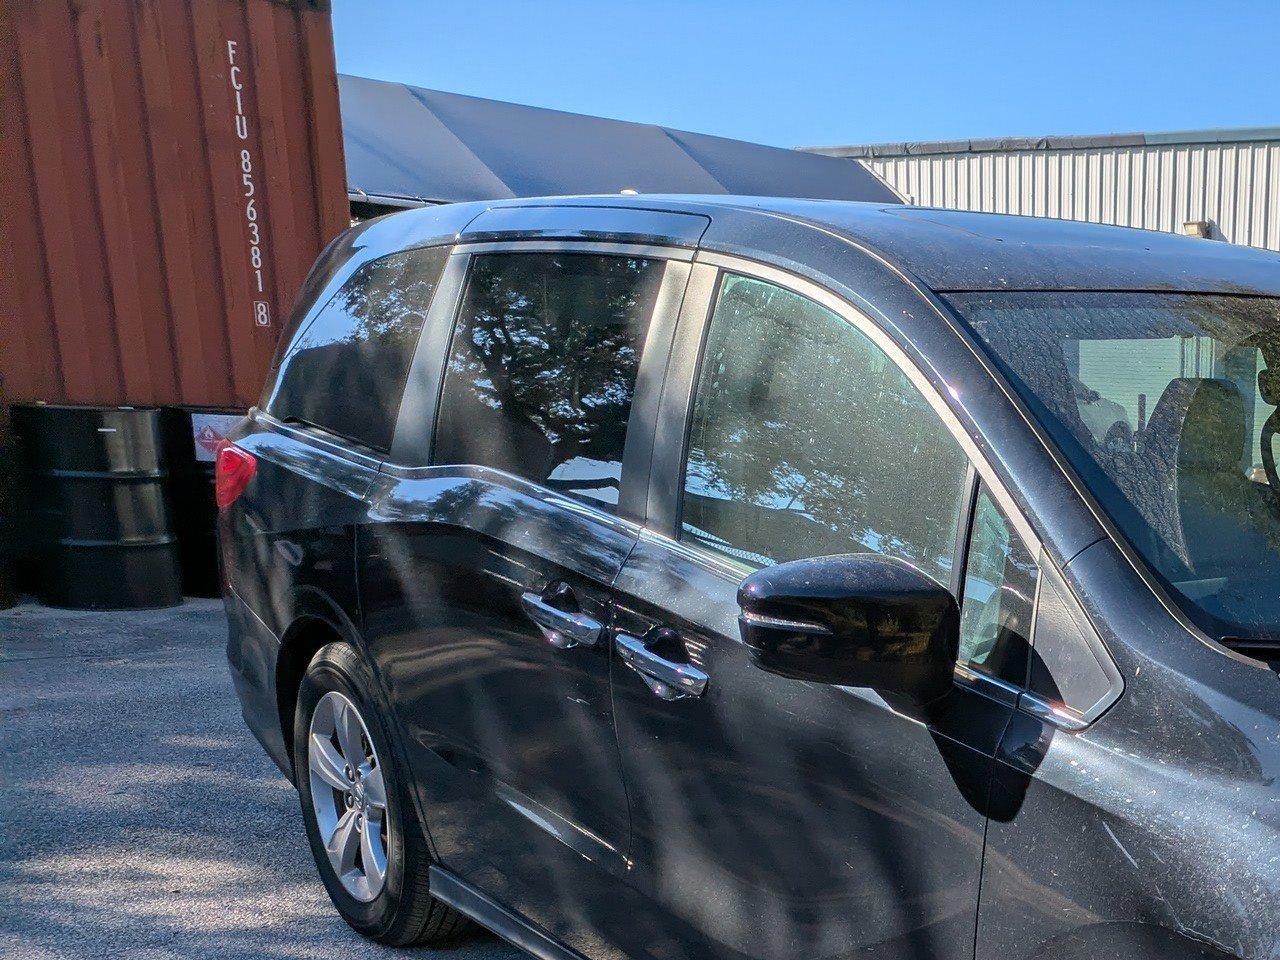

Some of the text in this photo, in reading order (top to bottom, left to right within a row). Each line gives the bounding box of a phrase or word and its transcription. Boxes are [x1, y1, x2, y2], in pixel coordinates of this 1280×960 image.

[227, 40, 268, 326] FCIU 856381 8
